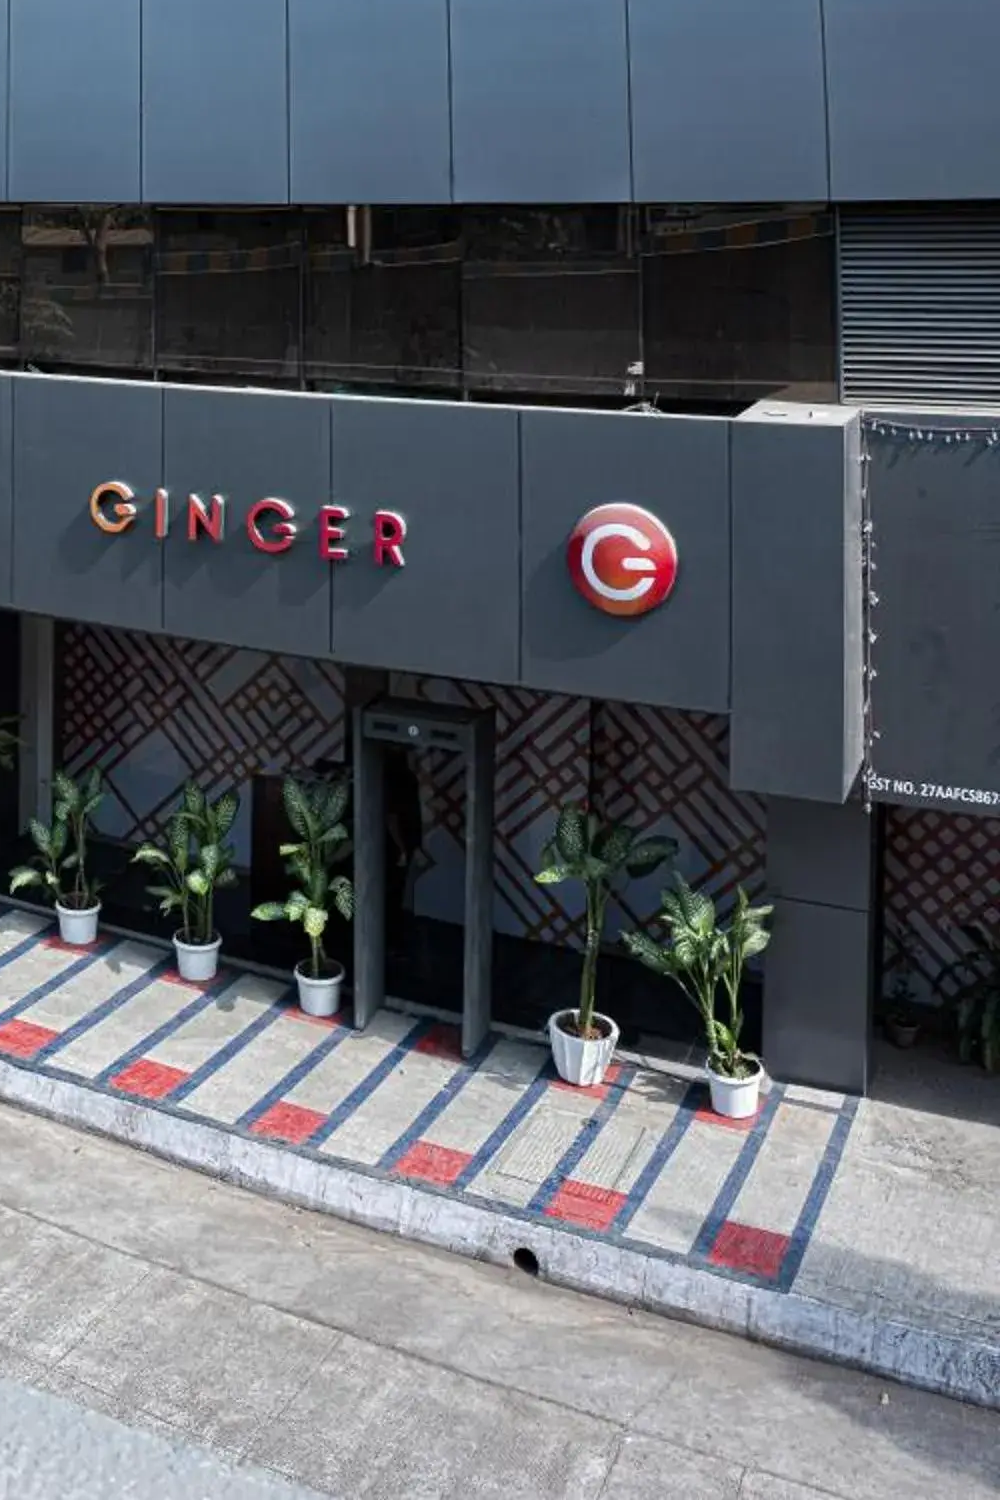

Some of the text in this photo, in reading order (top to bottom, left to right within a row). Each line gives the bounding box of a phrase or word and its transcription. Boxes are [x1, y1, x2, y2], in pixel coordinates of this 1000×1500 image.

[90, 481, 408, 568] GINGER
[868, 777, 1000, 805] GST NO. 27AAFCS867
